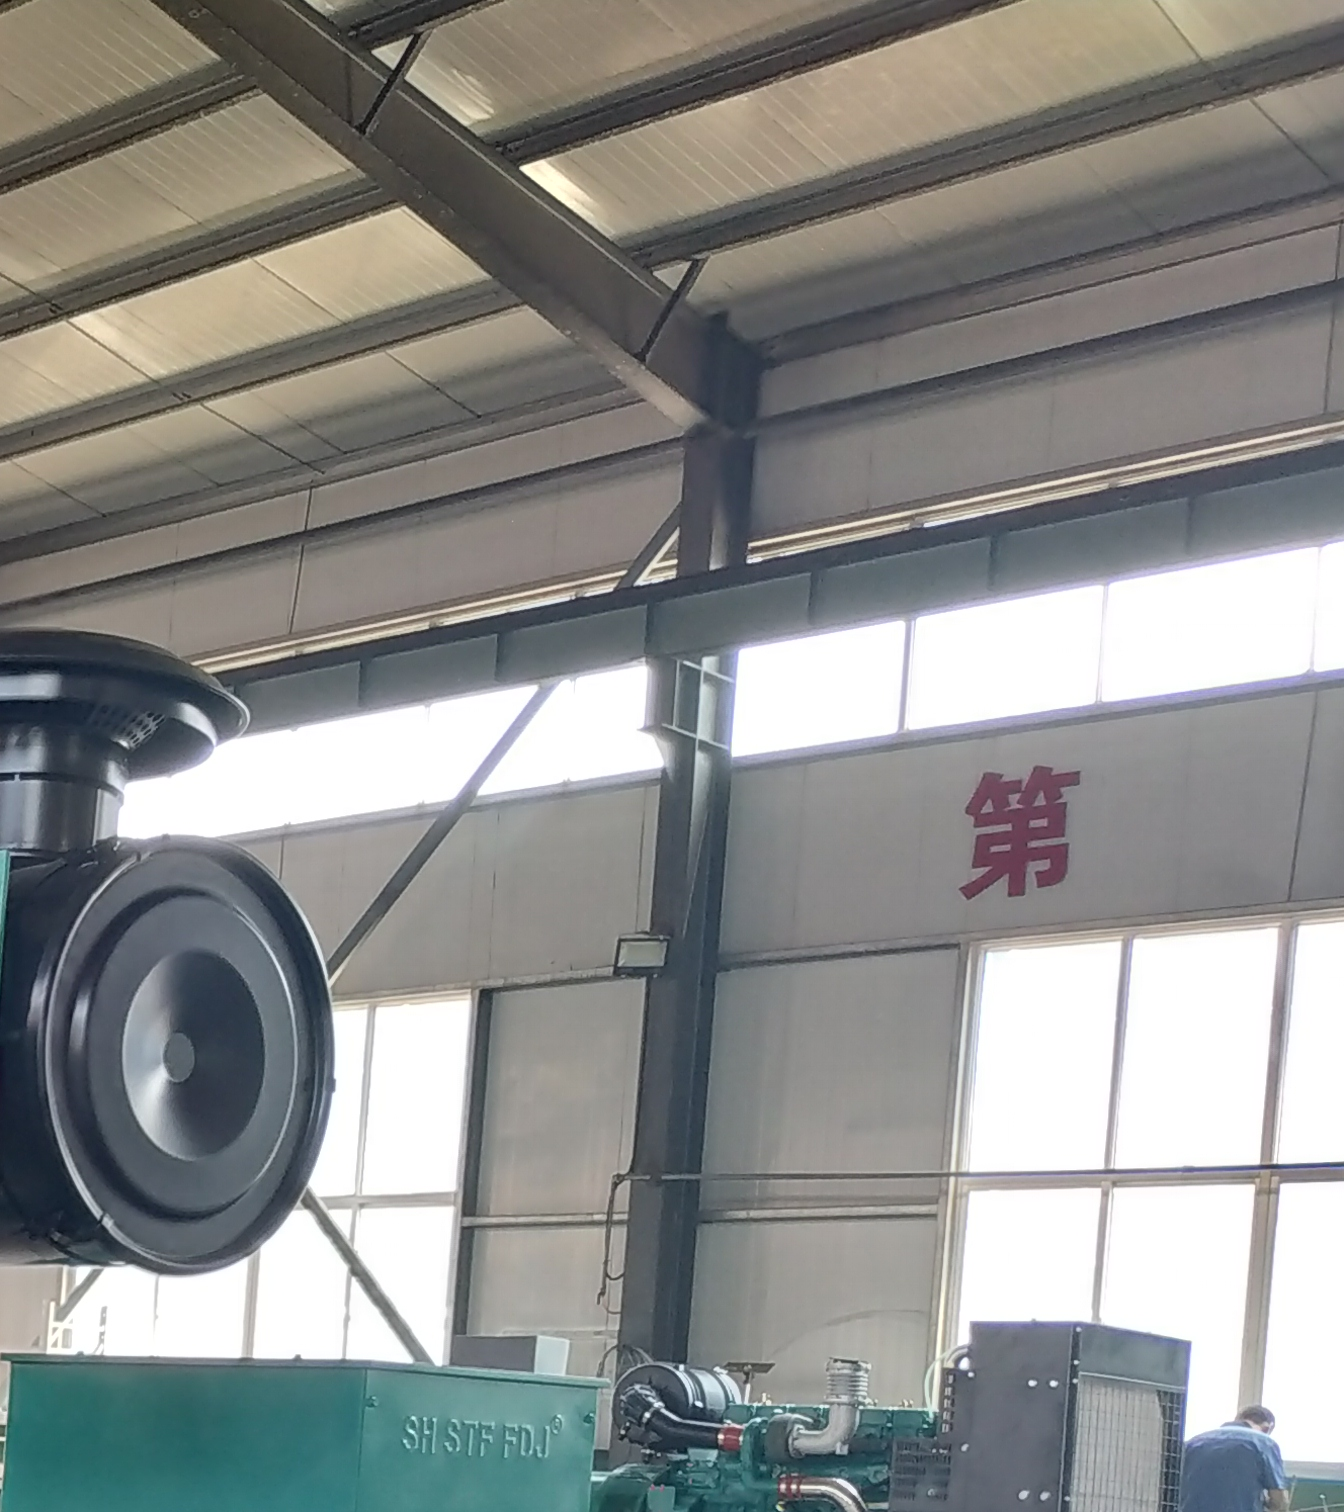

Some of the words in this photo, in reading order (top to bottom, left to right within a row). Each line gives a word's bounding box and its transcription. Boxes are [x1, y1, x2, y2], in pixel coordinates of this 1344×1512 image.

[959, 766, 1081, 900] 第
[402, 1415, 438, 1454] SH
[443, 1418, 496, 1458] STF
